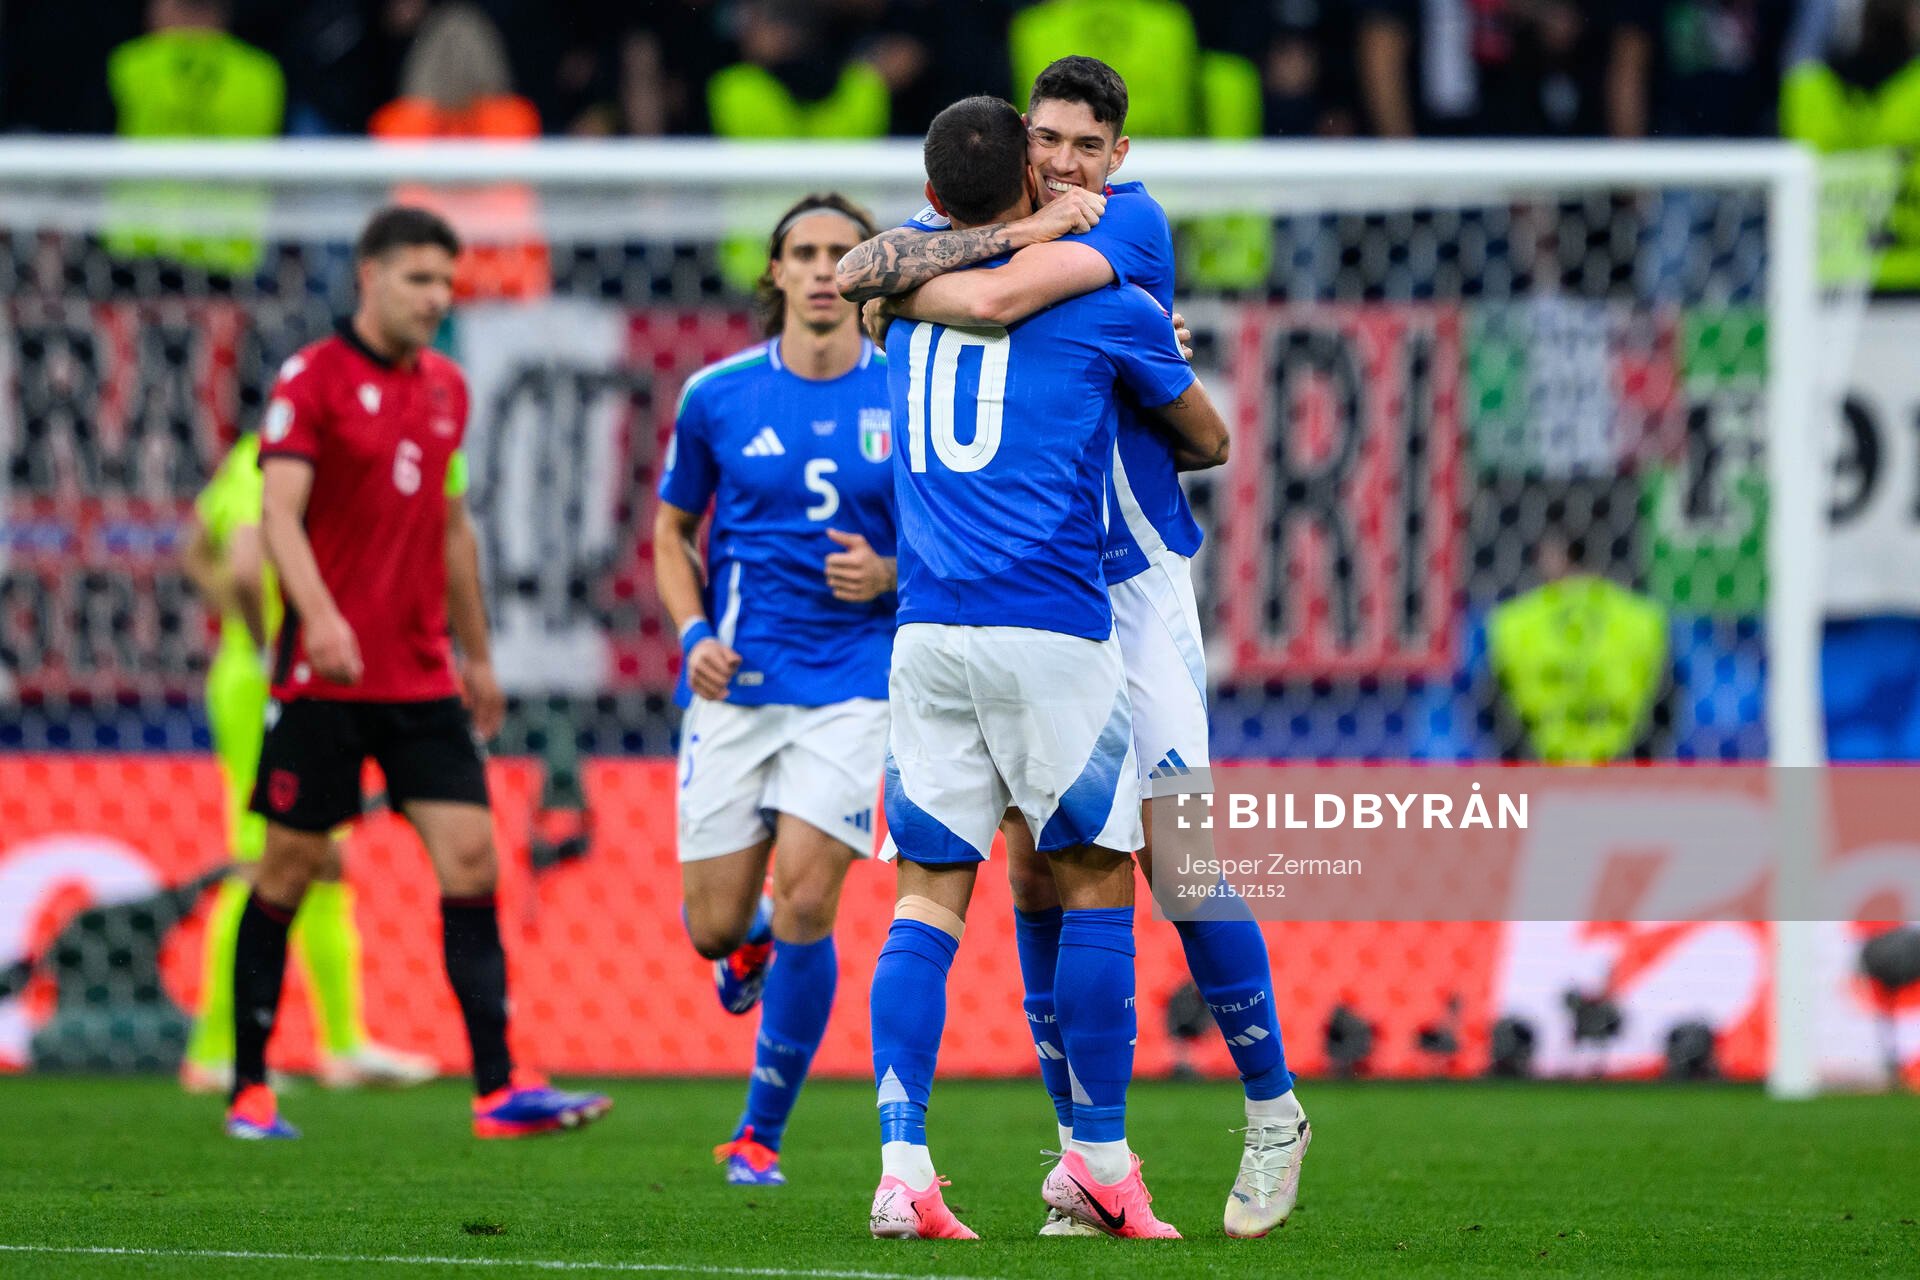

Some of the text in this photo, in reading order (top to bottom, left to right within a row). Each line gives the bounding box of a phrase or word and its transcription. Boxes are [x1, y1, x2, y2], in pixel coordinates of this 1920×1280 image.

[908, 321, 1010, 474] 10
[392, 438, 422, 497] 6
[804, 458, 840, 522] 5
